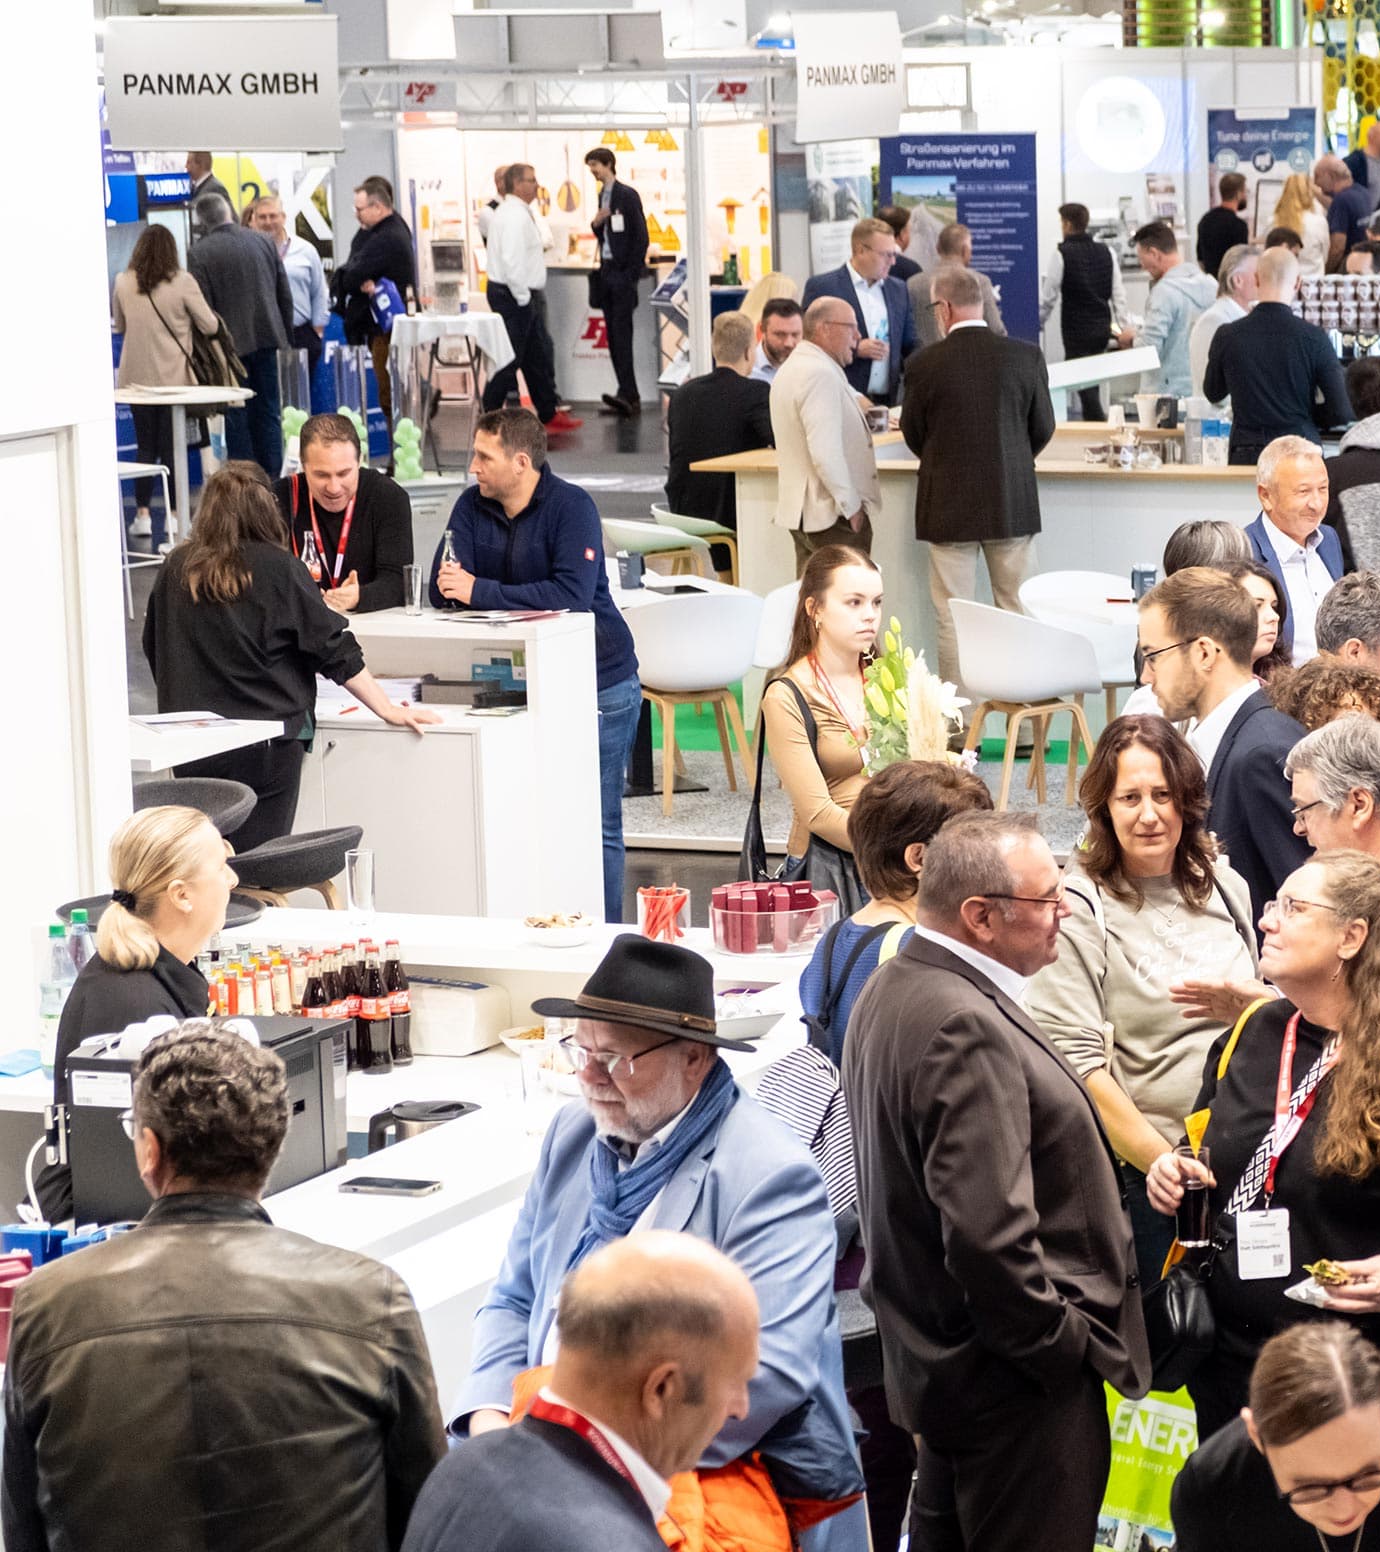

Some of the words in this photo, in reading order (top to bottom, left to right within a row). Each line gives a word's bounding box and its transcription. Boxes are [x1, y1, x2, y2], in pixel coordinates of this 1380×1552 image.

[123, 74, 232, 95] PANMAX
[241, 73, 319, 95] GMBH
[807, 66, 857, 87] PANMAX
[861, 64, 896, 85] GMBH
[1216, 130, 1241, 142] Tune
[1242, 130, 1270, 142] deine
[900, 142, 999, 157] Straßensanierung
[1001, 143, 1016, 153] im
[907, 157, 1010, 169] Panmax-Verfahren
[146, 178, 191, 197] PANMAX
